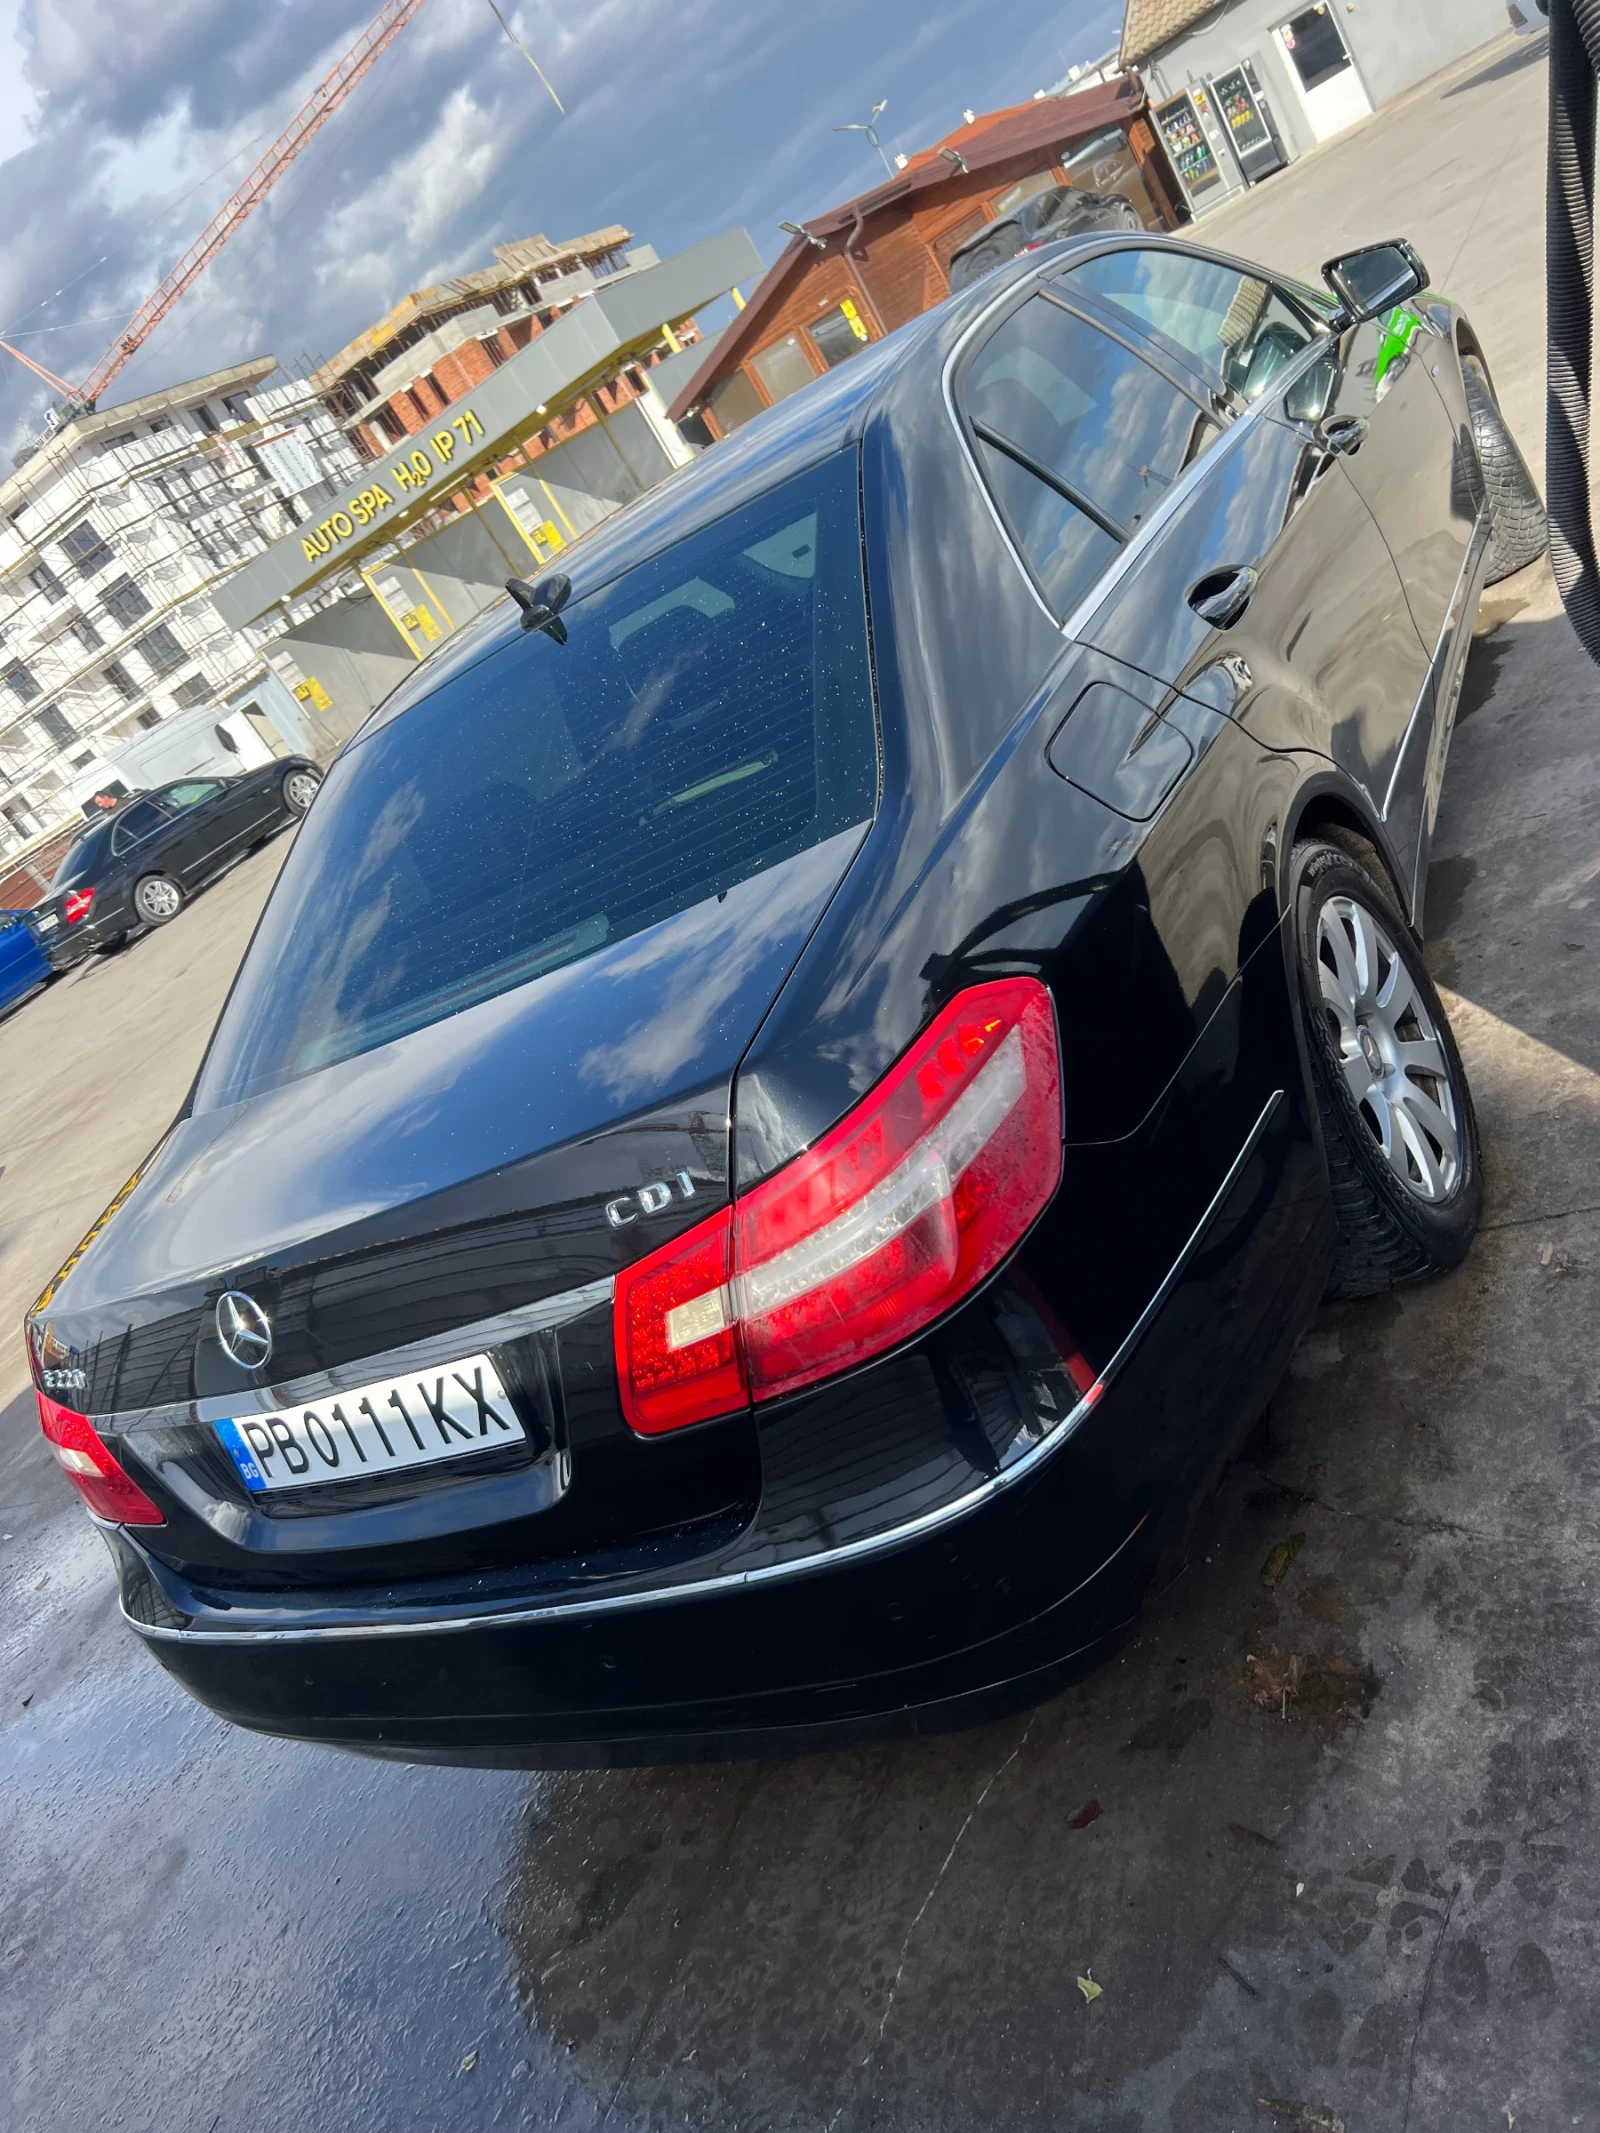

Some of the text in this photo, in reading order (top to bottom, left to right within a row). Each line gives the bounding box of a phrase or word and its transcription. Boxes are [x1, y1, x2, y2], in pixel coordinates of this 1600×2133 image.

[301, 512, 355, 563] AUTO
[348, 483, 395, 526] SPA
[429, 430, 456, 465] IP
[451, 409, 486, 447] 71
[605, 1171, 696, 1229] CDI
[240, 1461, 260, 1480] BG
